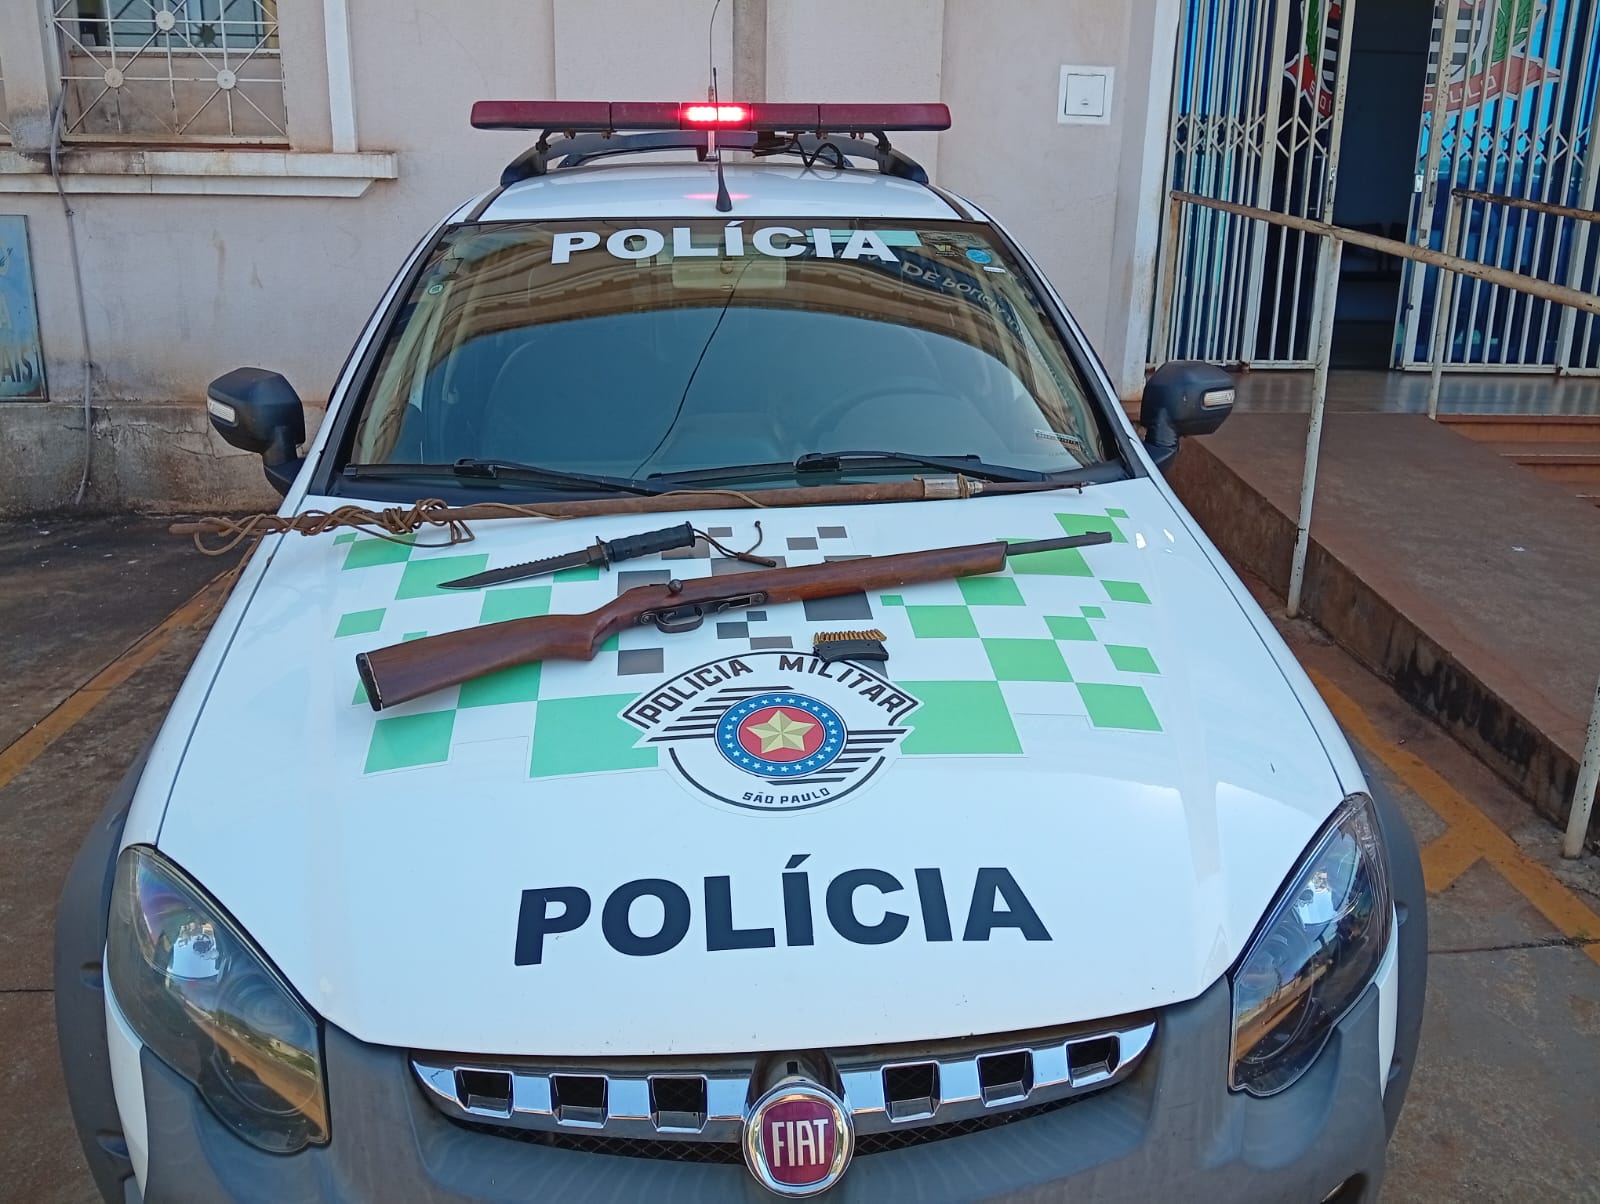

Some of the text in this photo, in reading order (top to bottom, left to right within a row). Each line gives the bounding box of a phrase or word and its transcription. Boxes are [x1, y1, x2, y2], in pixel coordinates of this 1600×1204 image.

[551, 220, 900, 264] POLÍCIA
[635, 654, 907, 724] POLICIA MILITAR
[741, 787, 831, 804] SÃO PAULO
[514, 853, 1053, 967] POLÍCIA
[771, 1118, 829, 1167] FIAT
